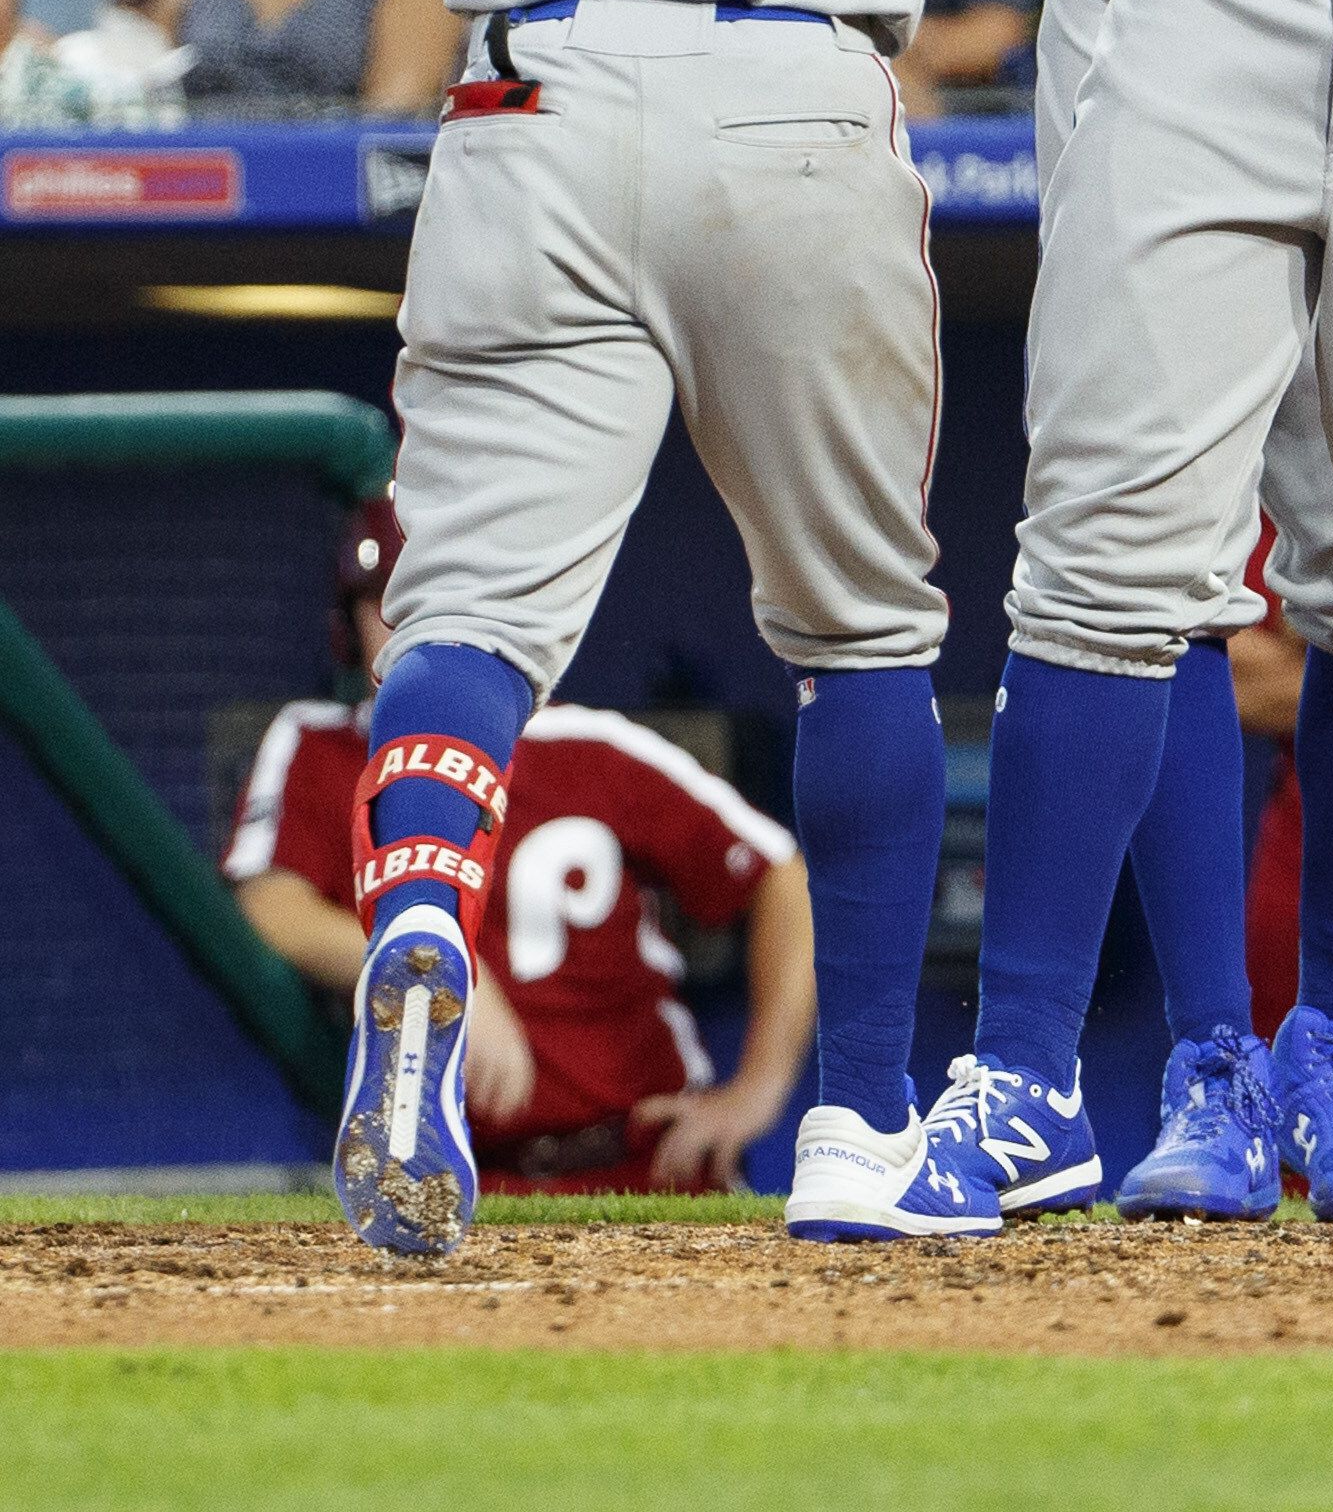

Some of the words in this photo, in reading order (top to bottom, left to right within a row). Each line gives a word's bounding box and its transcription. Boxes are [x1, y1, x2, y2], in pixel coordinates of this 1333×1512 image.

[376, 743, 508, 824] ALBIE
[506, 815, 624, 984] P
[812, 1145, 887, 1176] ARMOUR
